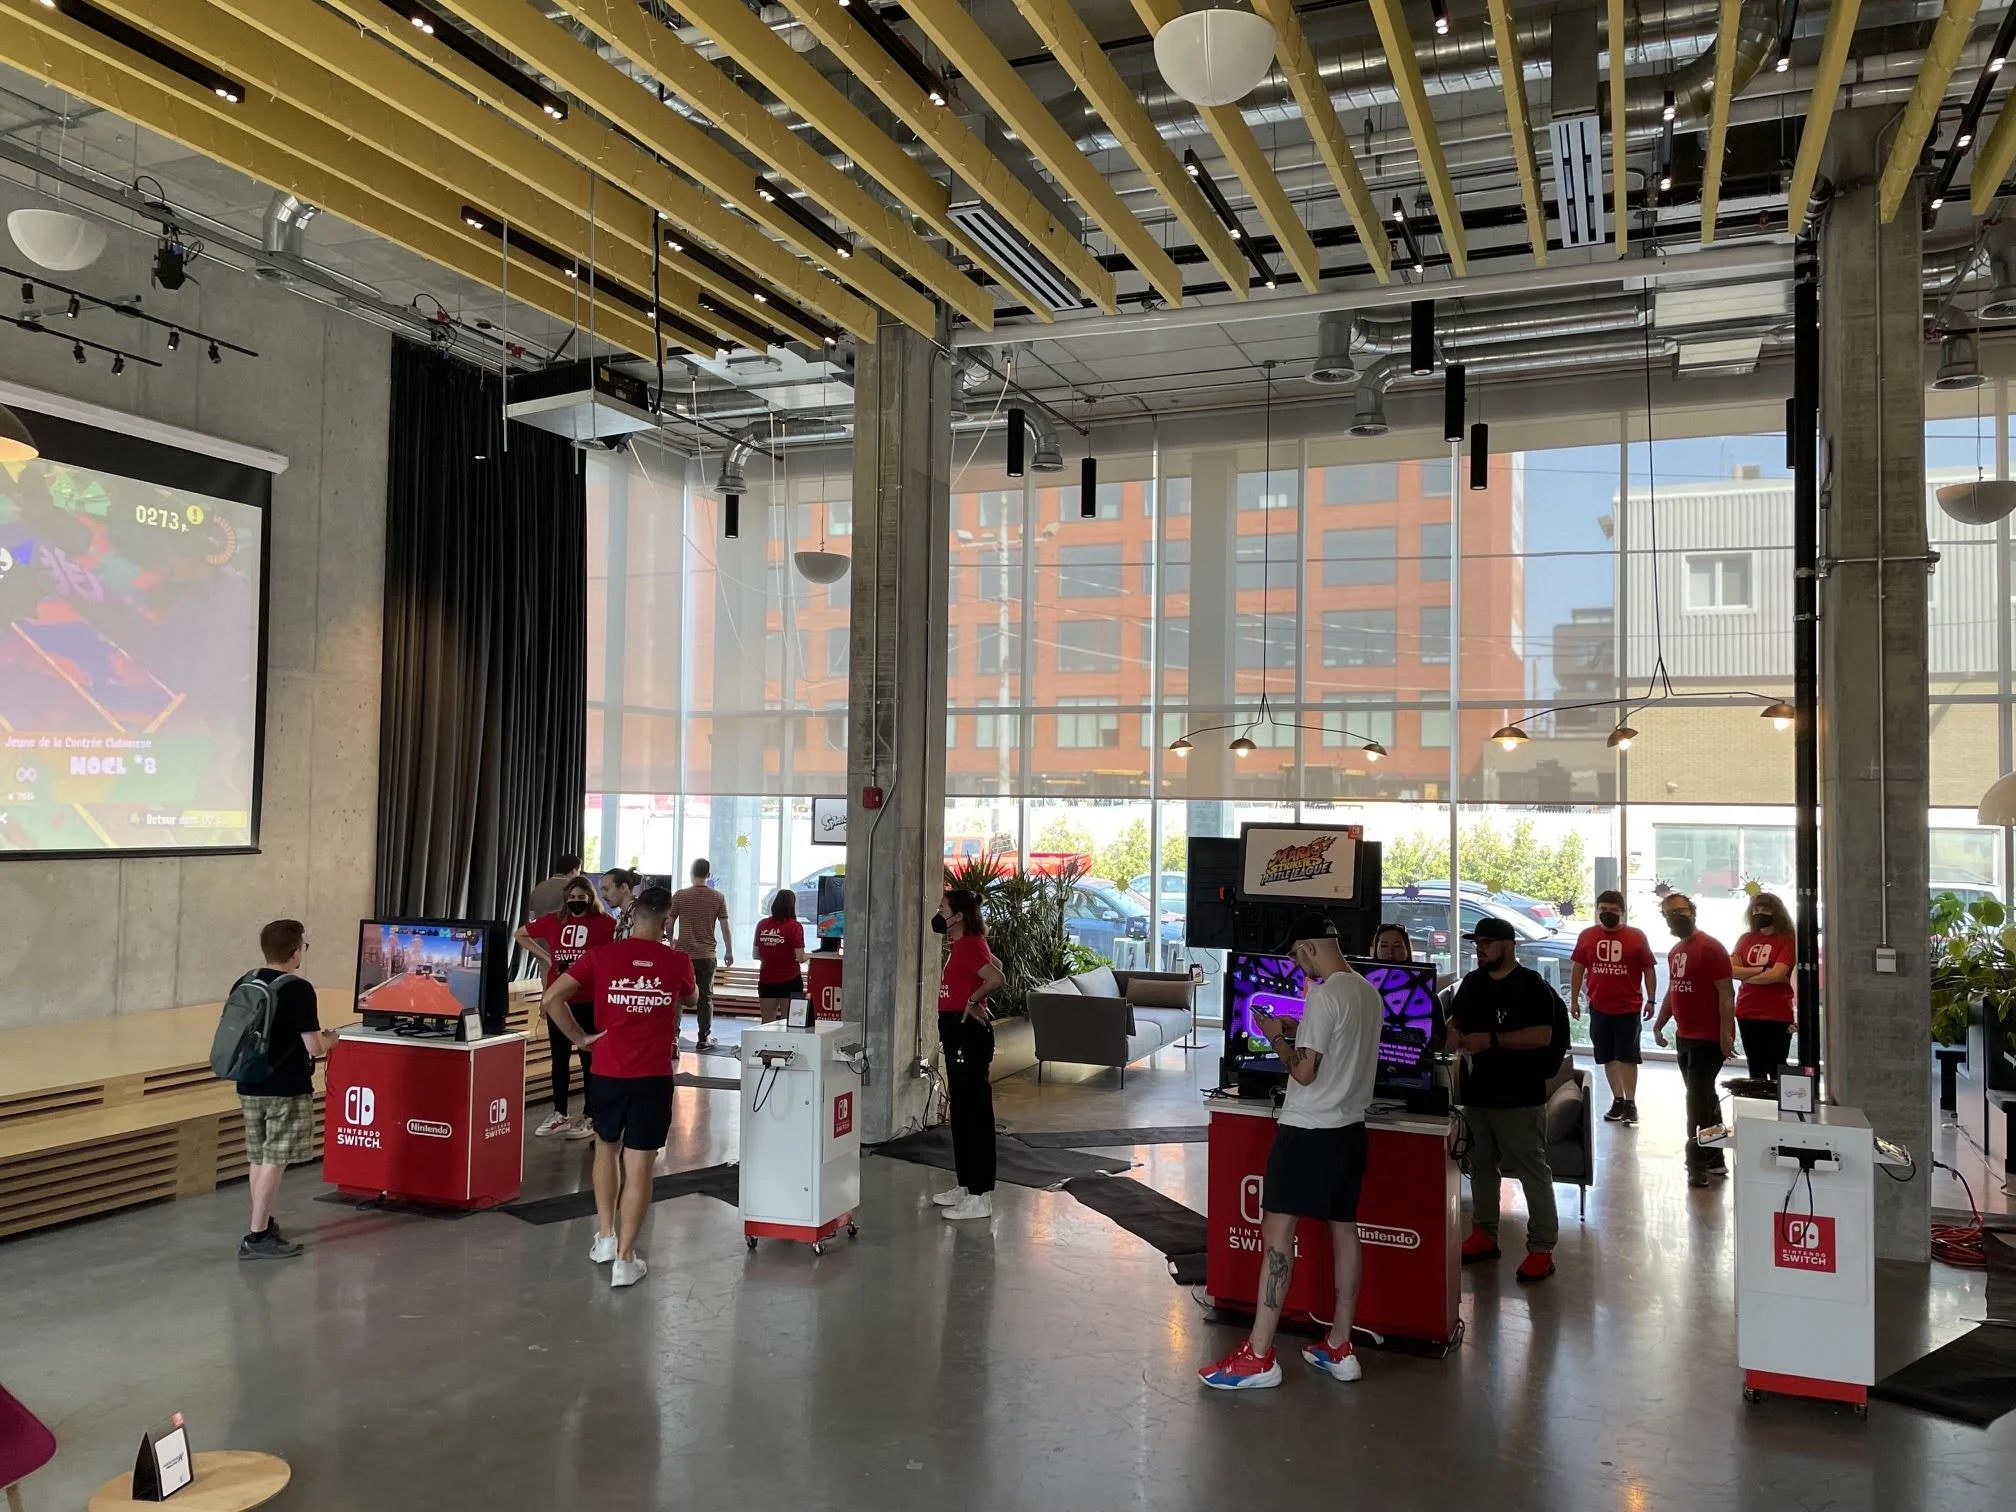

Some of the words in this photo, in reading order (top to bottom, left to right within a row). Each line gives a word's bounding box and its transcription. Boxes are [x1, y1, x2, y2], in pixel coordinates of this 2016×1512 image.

[135, 505, 180, 530] 0273
[38, 736, 50, 748] de
[53, 736, 63, 748] la
[146, 813, 177, 825] Retour
[1273, 841, 1327, 863] MARIO
[1267, 856, 1323, 875] STRIKERS
[1260, 870, 1291, 886] BATTLE
[1290, 862, 1331, 881] LEAGUE
[1592, 966, 1628, 976] SWITCH
[607, 993, 673, 1006] NINTENDO
[626, 1005, 653, 1014] CREW
[337, 1126, 381, 1138] NINTENDO
[410, 1122, 450, 1135] Nintendo
[485, 1126, 511, 1140] SWITCH
[337, 1134, 381, 1149] SWITCH
[1782, 1248, 1826, 1258] NINTENDO
[1782, 1253, 1826, 1266] SWITCH
